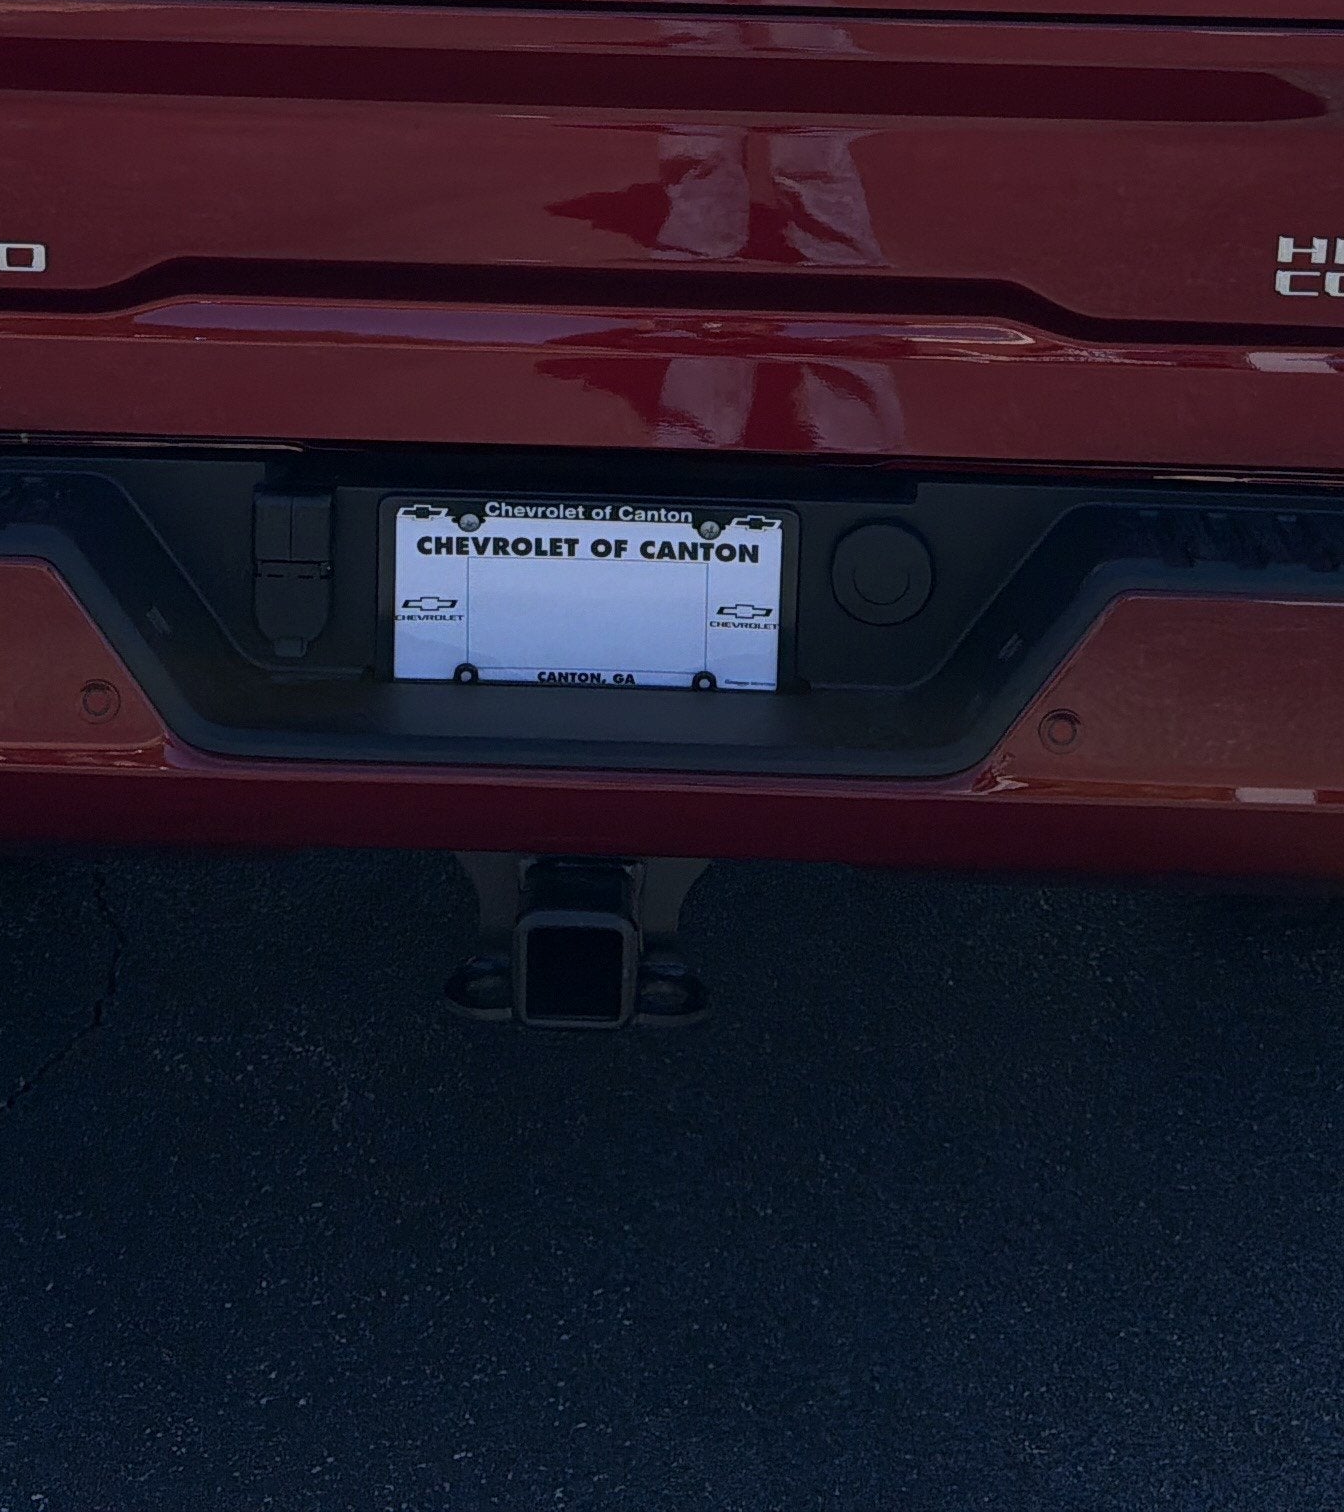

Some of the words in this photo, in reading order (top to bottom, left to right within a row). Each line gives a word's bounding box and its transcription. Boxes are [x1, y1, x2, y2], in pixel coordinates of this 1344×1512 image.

[484, 501, 585, 521] Chevrolet
[592, 505, 613, 521] of
[618, 506, 693, 524] Canton
[416, 536, 579, 558] CHEVROLET
[590, 539, 628, 559] OF
[639, 540, 759, 564] CANTON
[537, 672, 607, 684] CANTON,
[613, 673, 636, 685] GA
